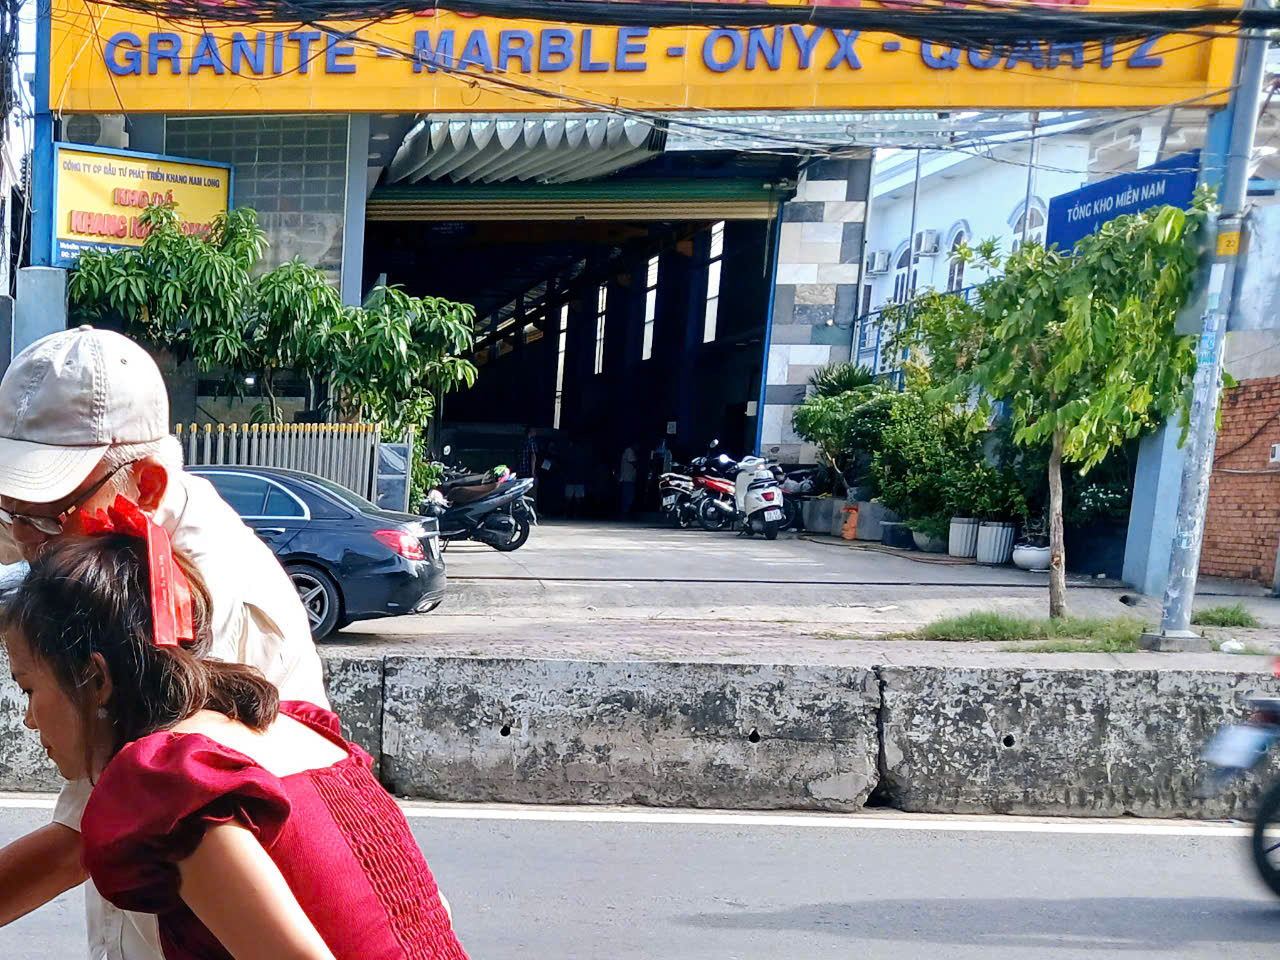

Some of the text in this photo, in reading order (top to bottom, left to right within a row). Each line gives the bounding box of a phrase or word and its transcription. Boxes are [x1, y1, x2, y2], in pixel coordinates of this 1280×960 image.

[105, 31, 357, 76] GRANITE
[413, 26, 650, 74] MARBLE
[703, 26, 863, 74] ONYX
[166, 173, 188, 185] KHANG
[189, 175, 203, 186] NAM
[204, 177, 220, 188] LONG
[1067, 179, 1166, 223] TỔNG KHO MIỀN NAM
[70, 210, 128, 238] KHANG
